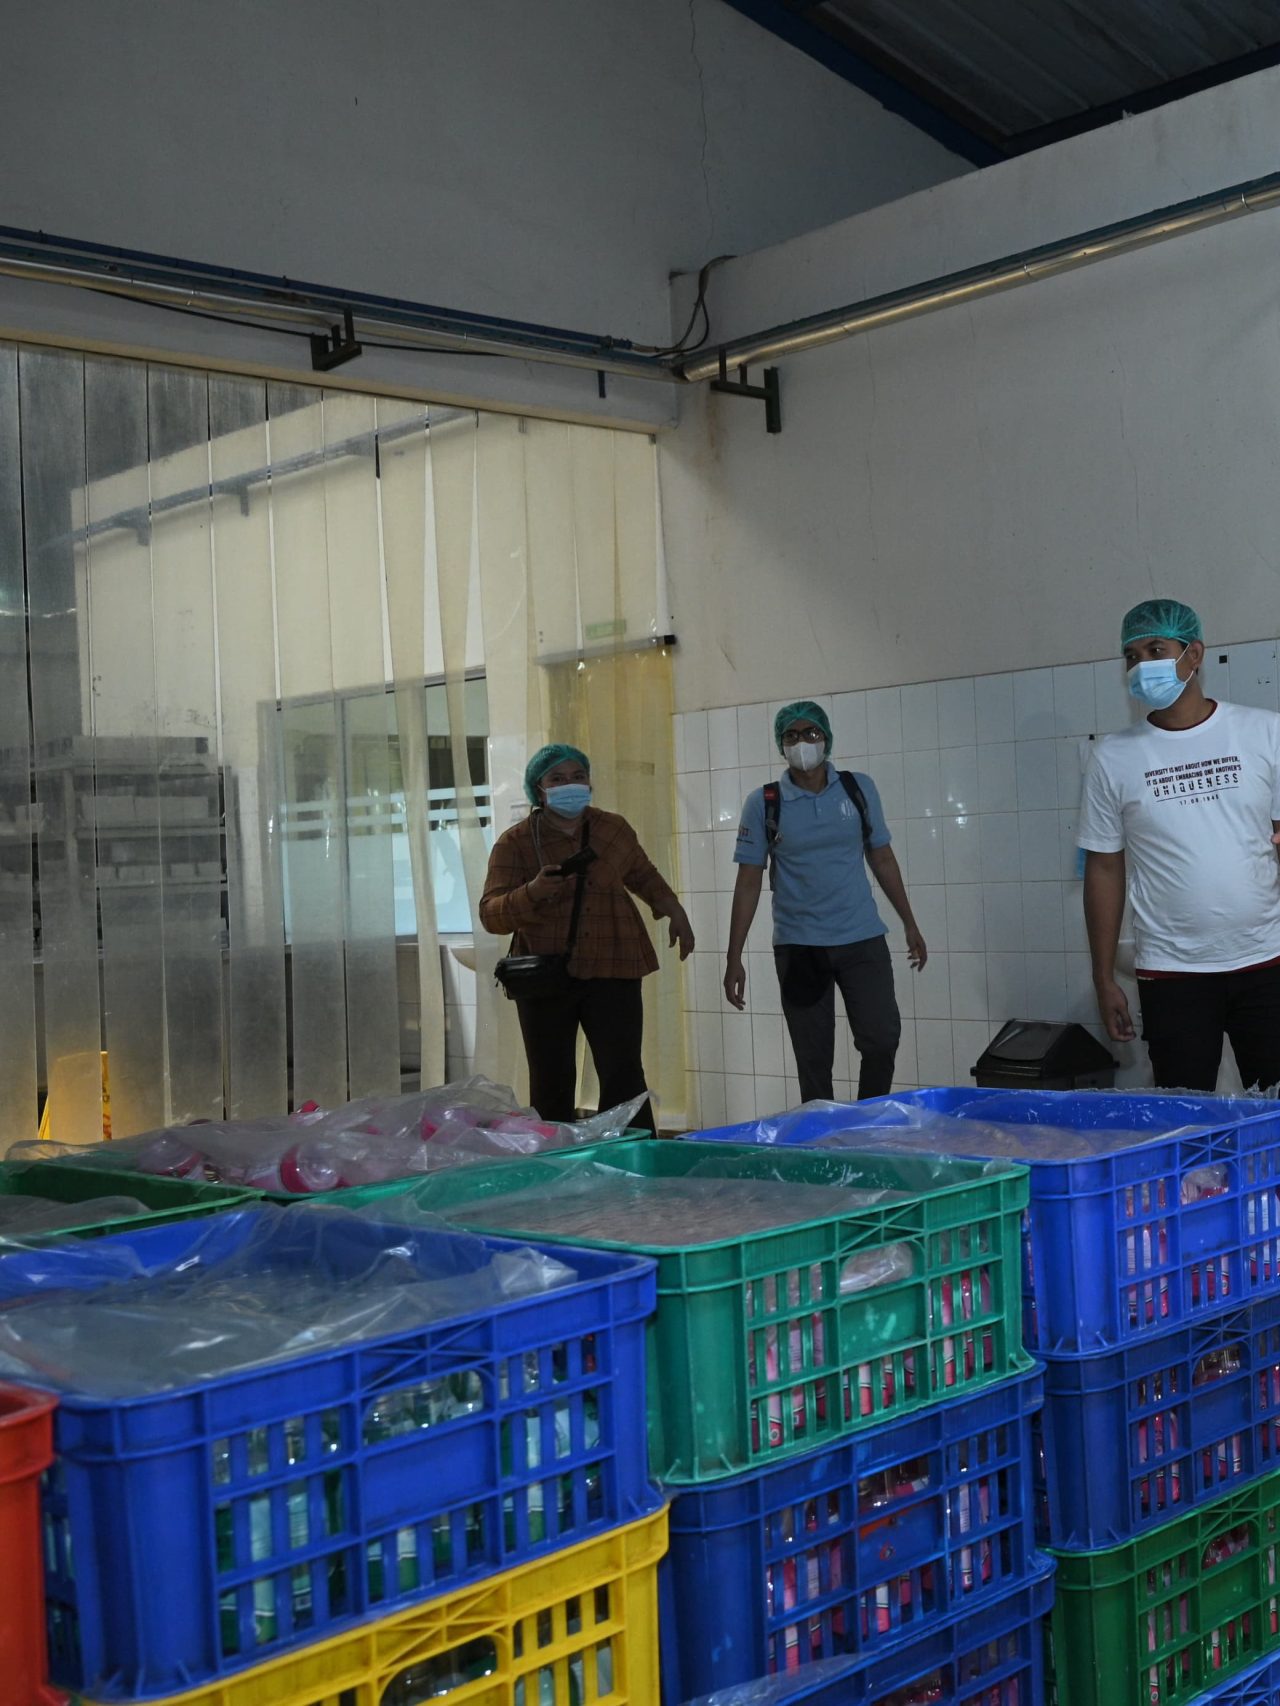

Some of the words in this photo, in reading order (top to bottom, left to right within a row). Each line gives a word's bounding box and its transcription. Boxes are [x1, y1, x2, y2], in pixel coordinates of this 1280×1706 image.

[1144, 767, 1168, 779] DIVERSITY
[1175, 765, 1185, 773] NOT
[1185, 762, 1200, 770] ABOUT
[1201, 760, 1212, 768] HOW
[1152, 778, 1158, 786] IS
[1159, 775, 1174, 784] ABOUT
[1175, 770, 1203, 781] EMBRACING
[1204, 768, 1214, 776] ONE
[1215, 764, 1242, 774] ANOTHER'S
[1153, 773, 1239, 798] UNIQUENESS
